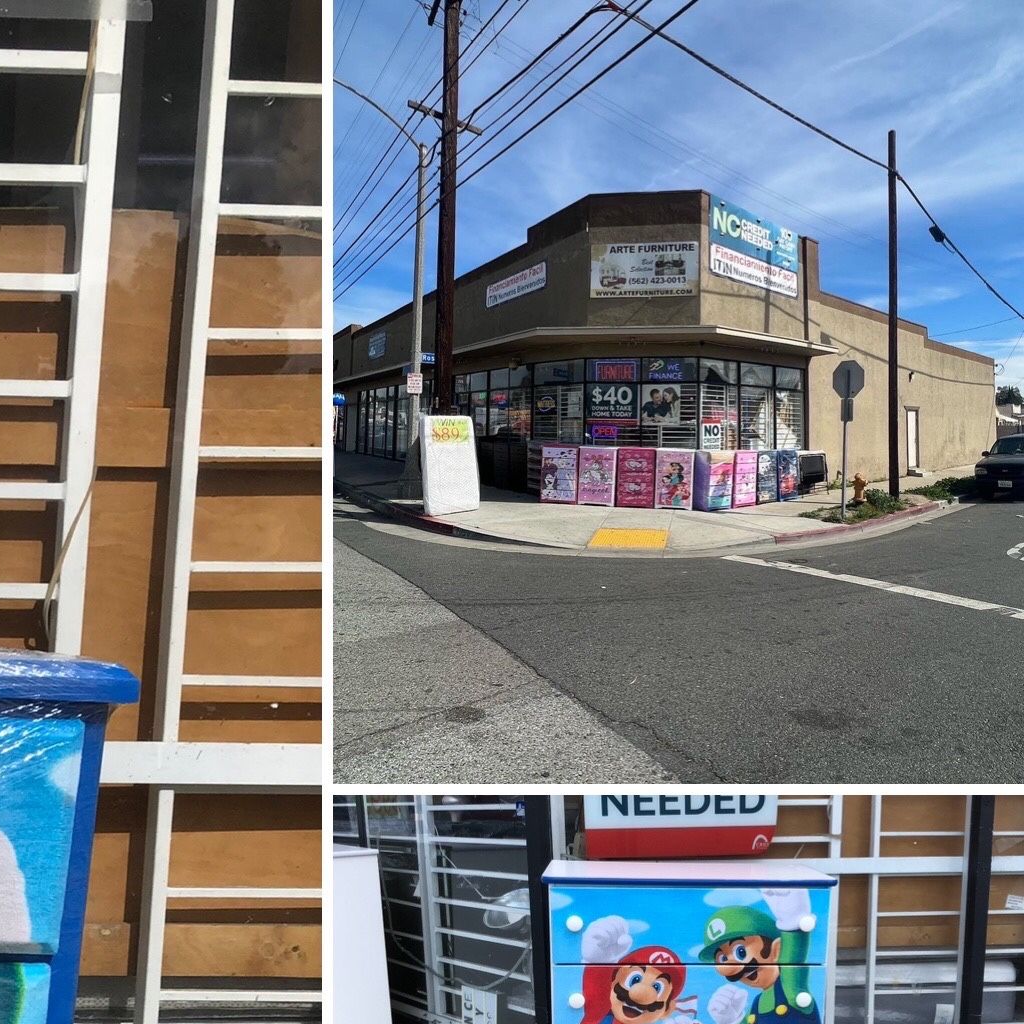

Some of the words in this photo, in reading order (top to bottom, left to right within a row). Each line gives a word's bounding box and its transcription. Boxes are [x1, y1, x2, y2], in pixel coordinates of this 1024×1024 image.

[713, 206, 741, 237] NO
[741, 219, 771, 240] CREDIT
[741, 230, 773, 250] NEEDED
[609, 245, 635, 254] ARTE
[638, 243, 695, 254] FURNITURE
[628, 277, 649, 285] (562)
[650, 276, 687, 285] 423-0013
[596, 289, 693, 297] WWW.ARTEFURNITURE.COM
[667, 363, 680, 371] WE
[648, 372, 684, 380] FINANCE
[591, 385, 633, 405] $40
[432, 427, 460, 441] $89
[595, 426, 616, 436] OPEN
[704, 425, 720, 437] NO
[601, 795, 766, 817] NEEDED
